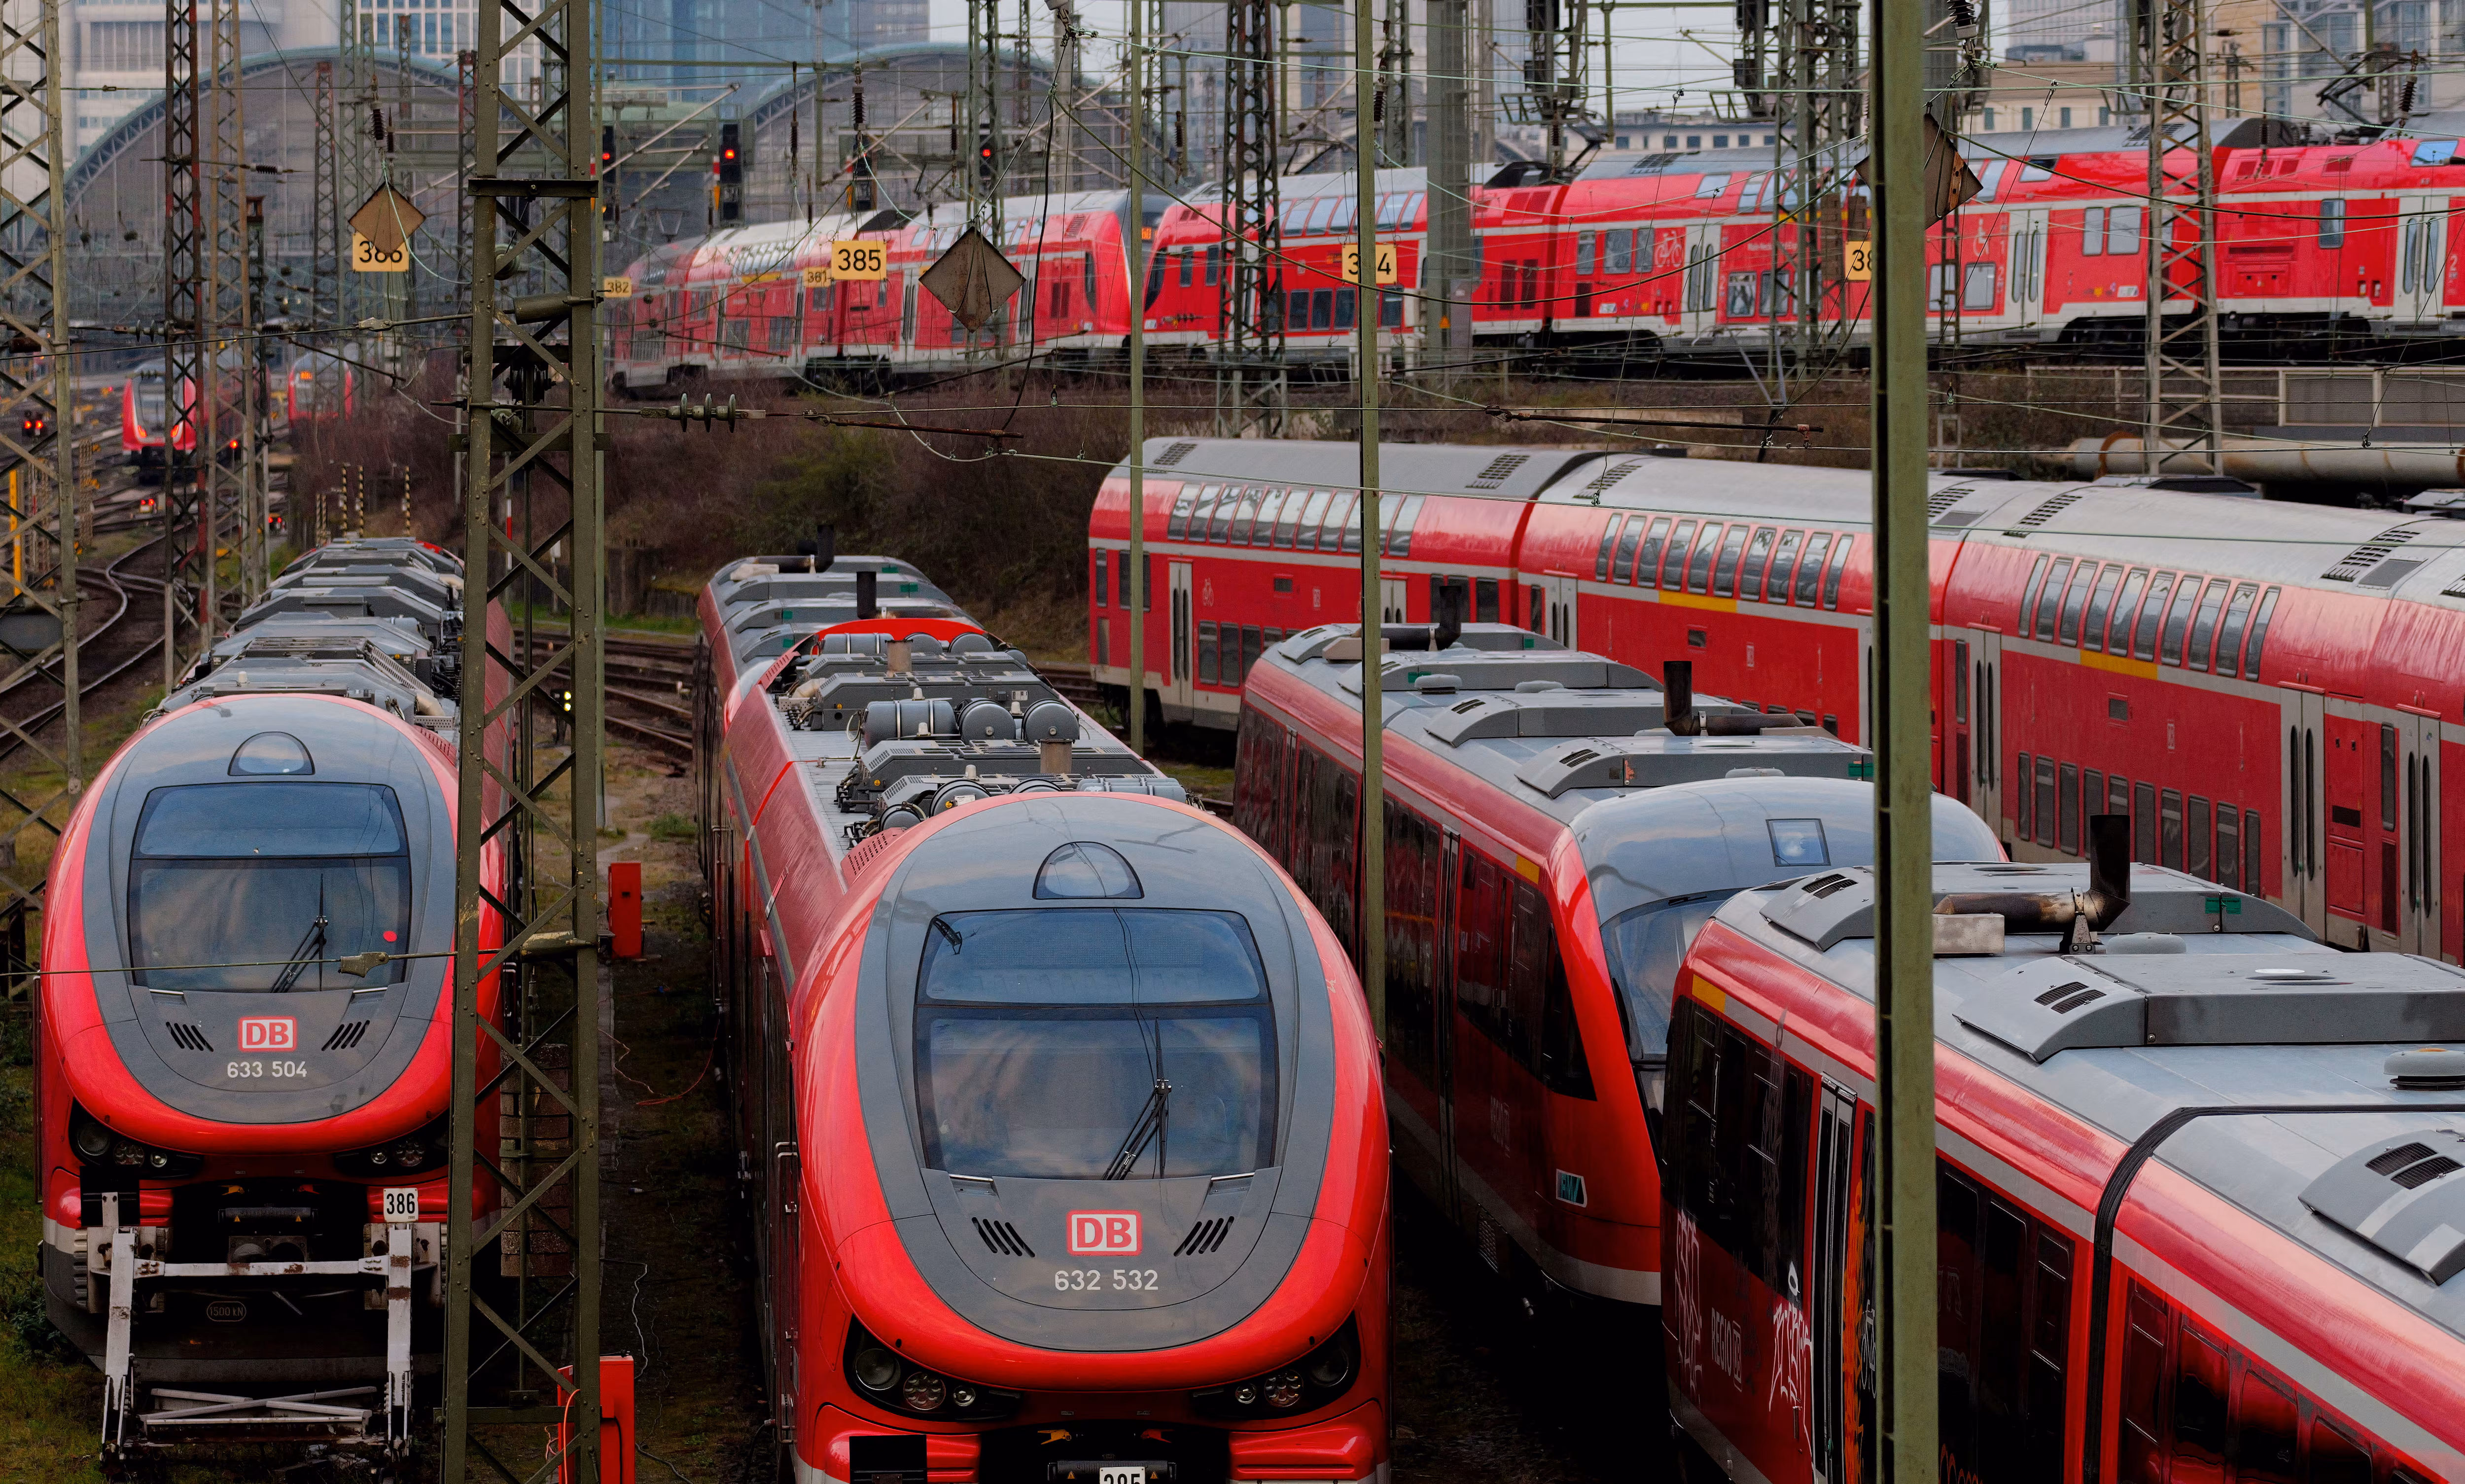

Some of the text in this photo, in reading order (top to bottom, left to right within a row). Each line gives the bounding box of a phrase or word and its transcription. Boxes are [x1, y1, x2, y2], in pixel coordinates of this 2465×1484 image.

[838, 248, 881, 271] 385
[1348, 253, 1391, 275] 34
[2449, 254, 2458, 271] 2
[608, 280, 629, 293] 382
[808, 271, 827, 283] 381
[245, 1021, 290, 1047] DB
[227, 1061, 307, 1078] 633 504
[387, 1193, 415, 1214] 386
[1075, 1216, 1133, 1249] DB
[1055, 1270, 1159, 1291] 632 532
[210, 1307, 243, 1316] 1500 kN
[1712, 1307, 1732, 1377] REGIO
